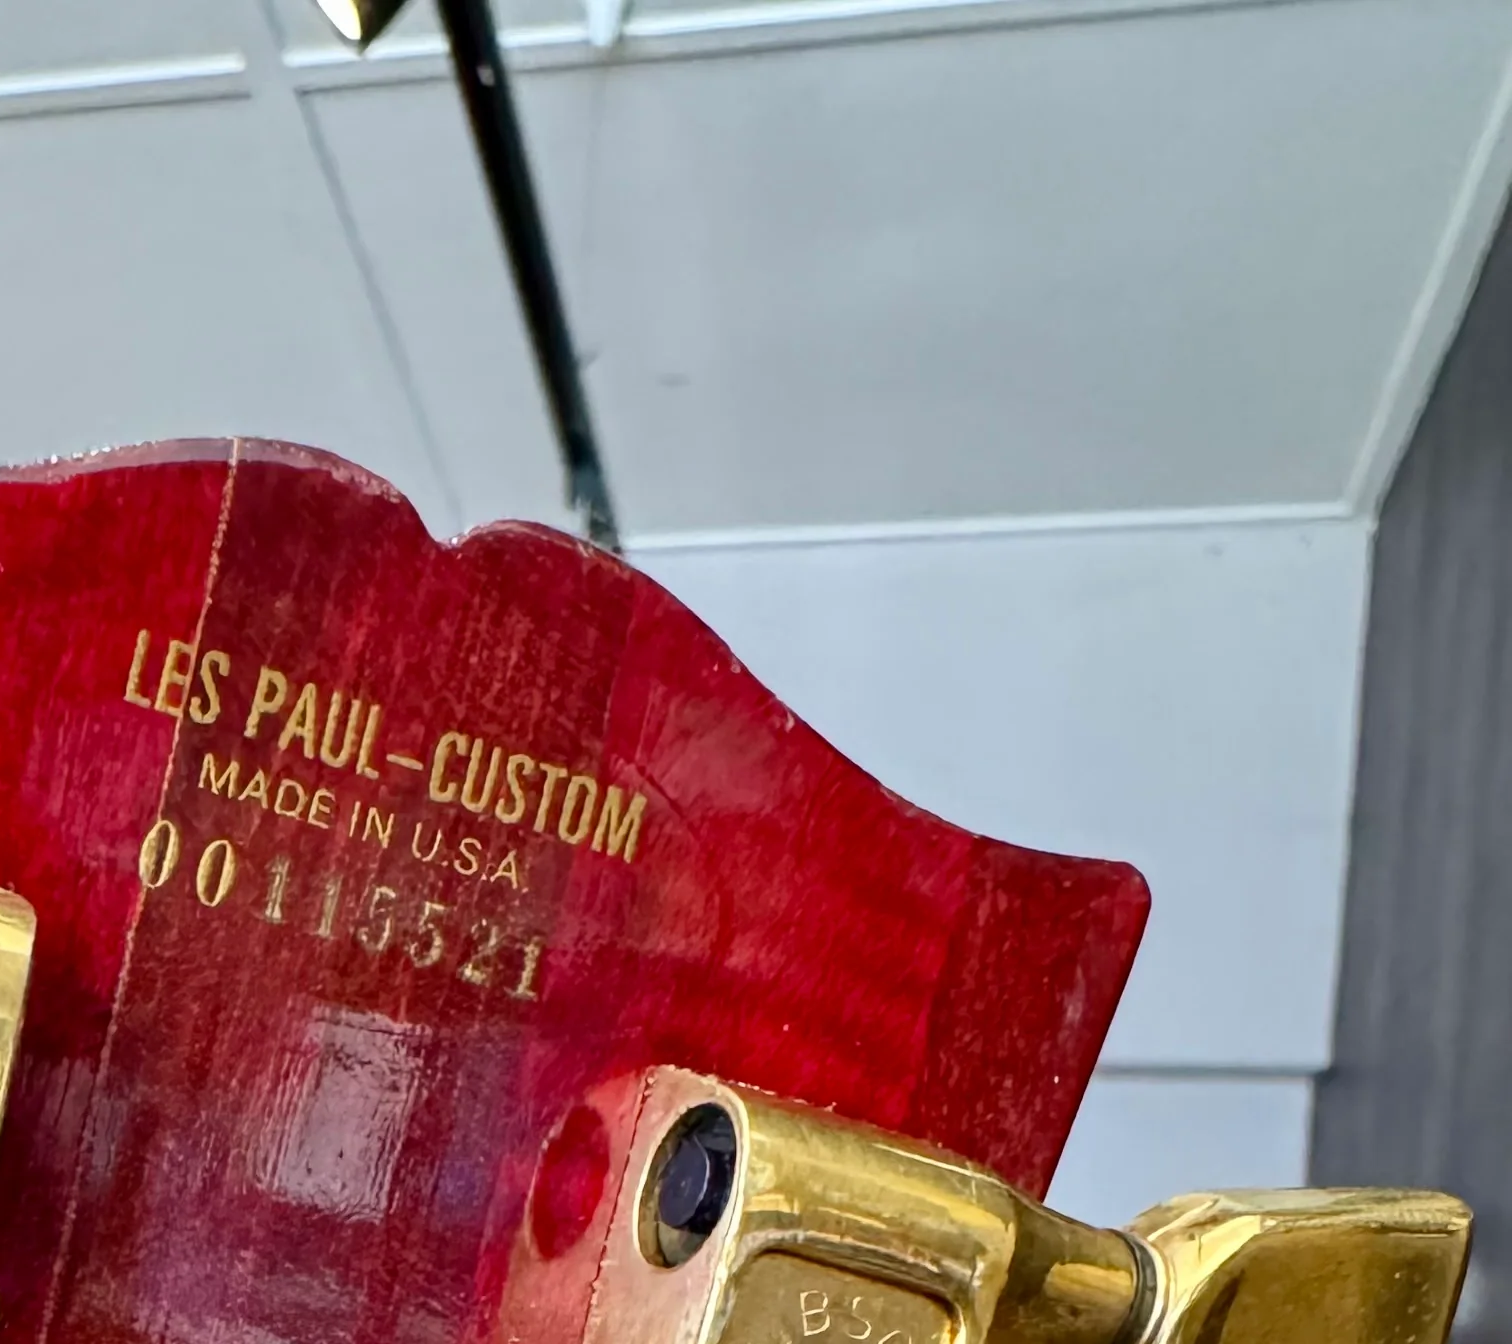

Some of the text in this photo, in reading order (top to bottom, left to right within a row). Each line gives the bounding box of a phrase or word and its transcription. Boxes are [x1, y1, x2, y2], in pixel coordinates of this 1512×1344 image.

[123, 628, 231, 725] LES
[197, 752, 337, 830] MADE
[348, 801, 396, 849] IN
